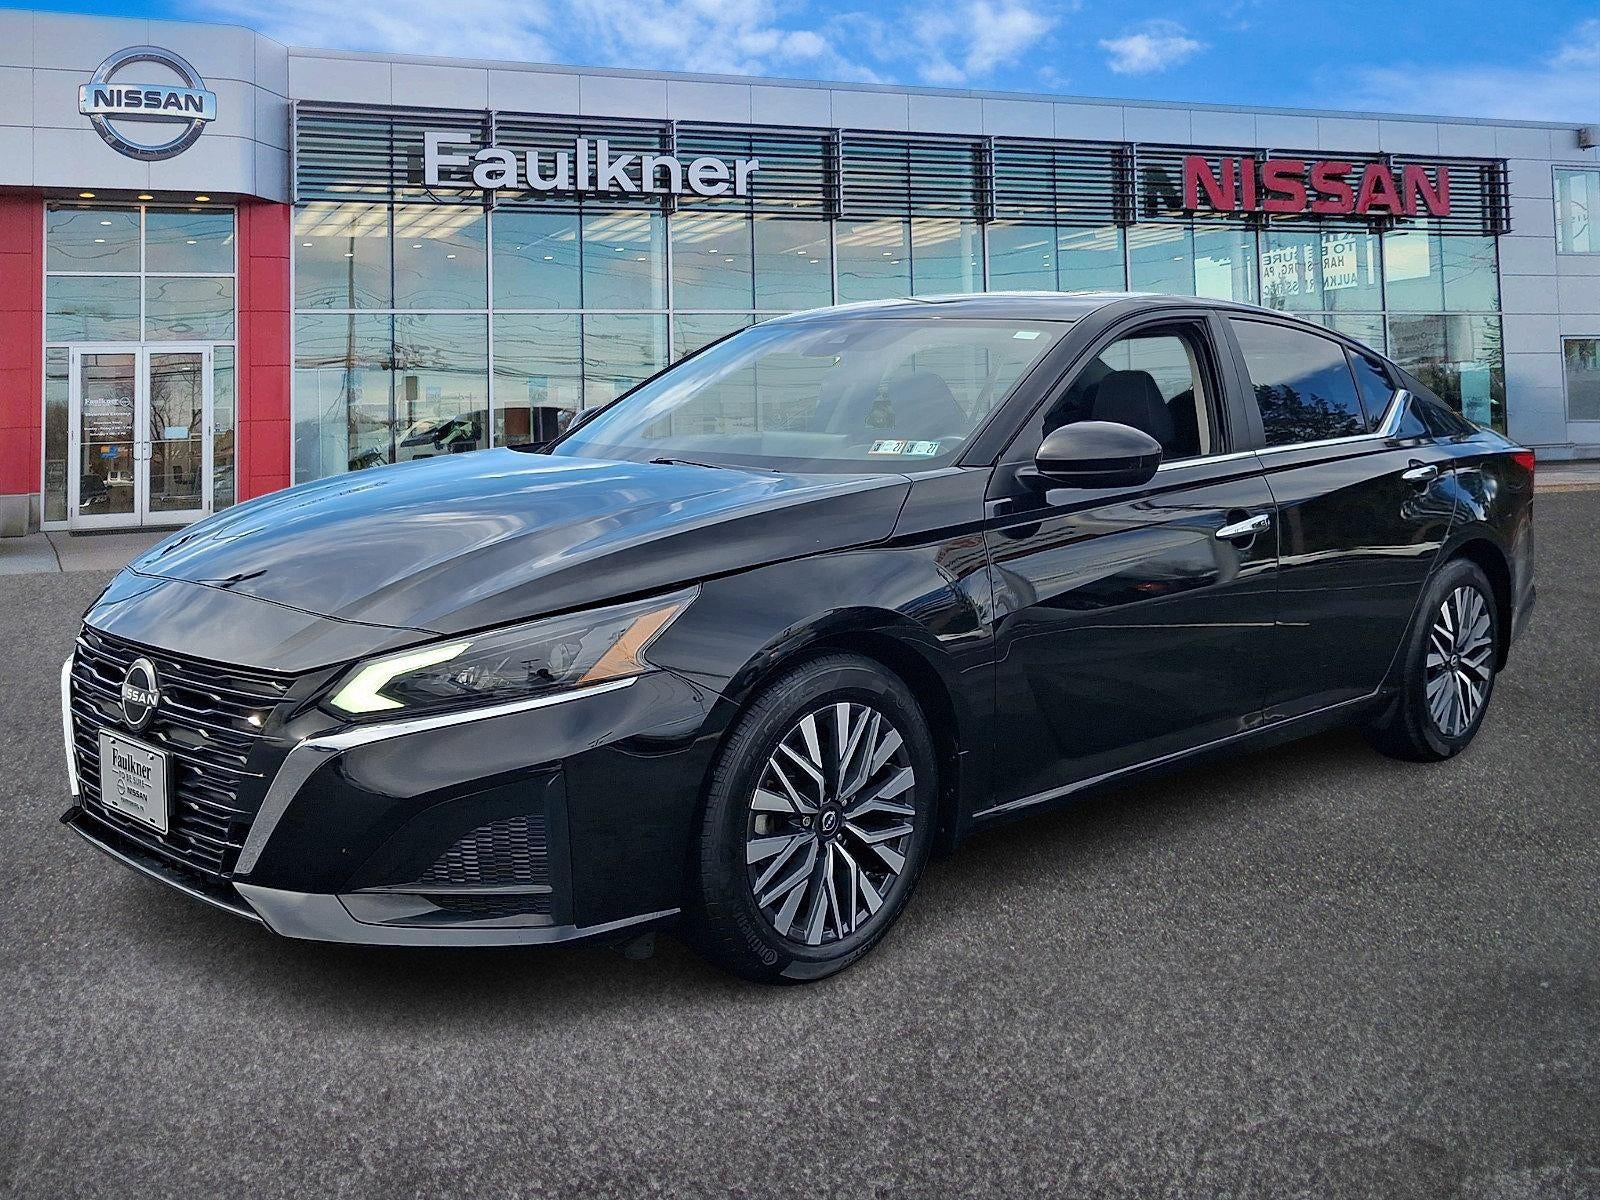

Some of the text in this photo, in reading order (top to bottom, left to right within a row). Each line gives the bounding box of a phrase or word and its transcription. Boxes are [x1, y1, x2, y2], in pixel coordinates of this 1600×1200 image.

[93, 89, 203, 113] NISSAN
[423, 131, 760, 197] Faulkner
[1182, 155, 1451, 217] NISSAN
[892, 442, 904, 452] 27
[926, 444, 938, 454] 27
[125, 688, 157, 706] SSAN
[112, 747, 152, 781] Faulkner
